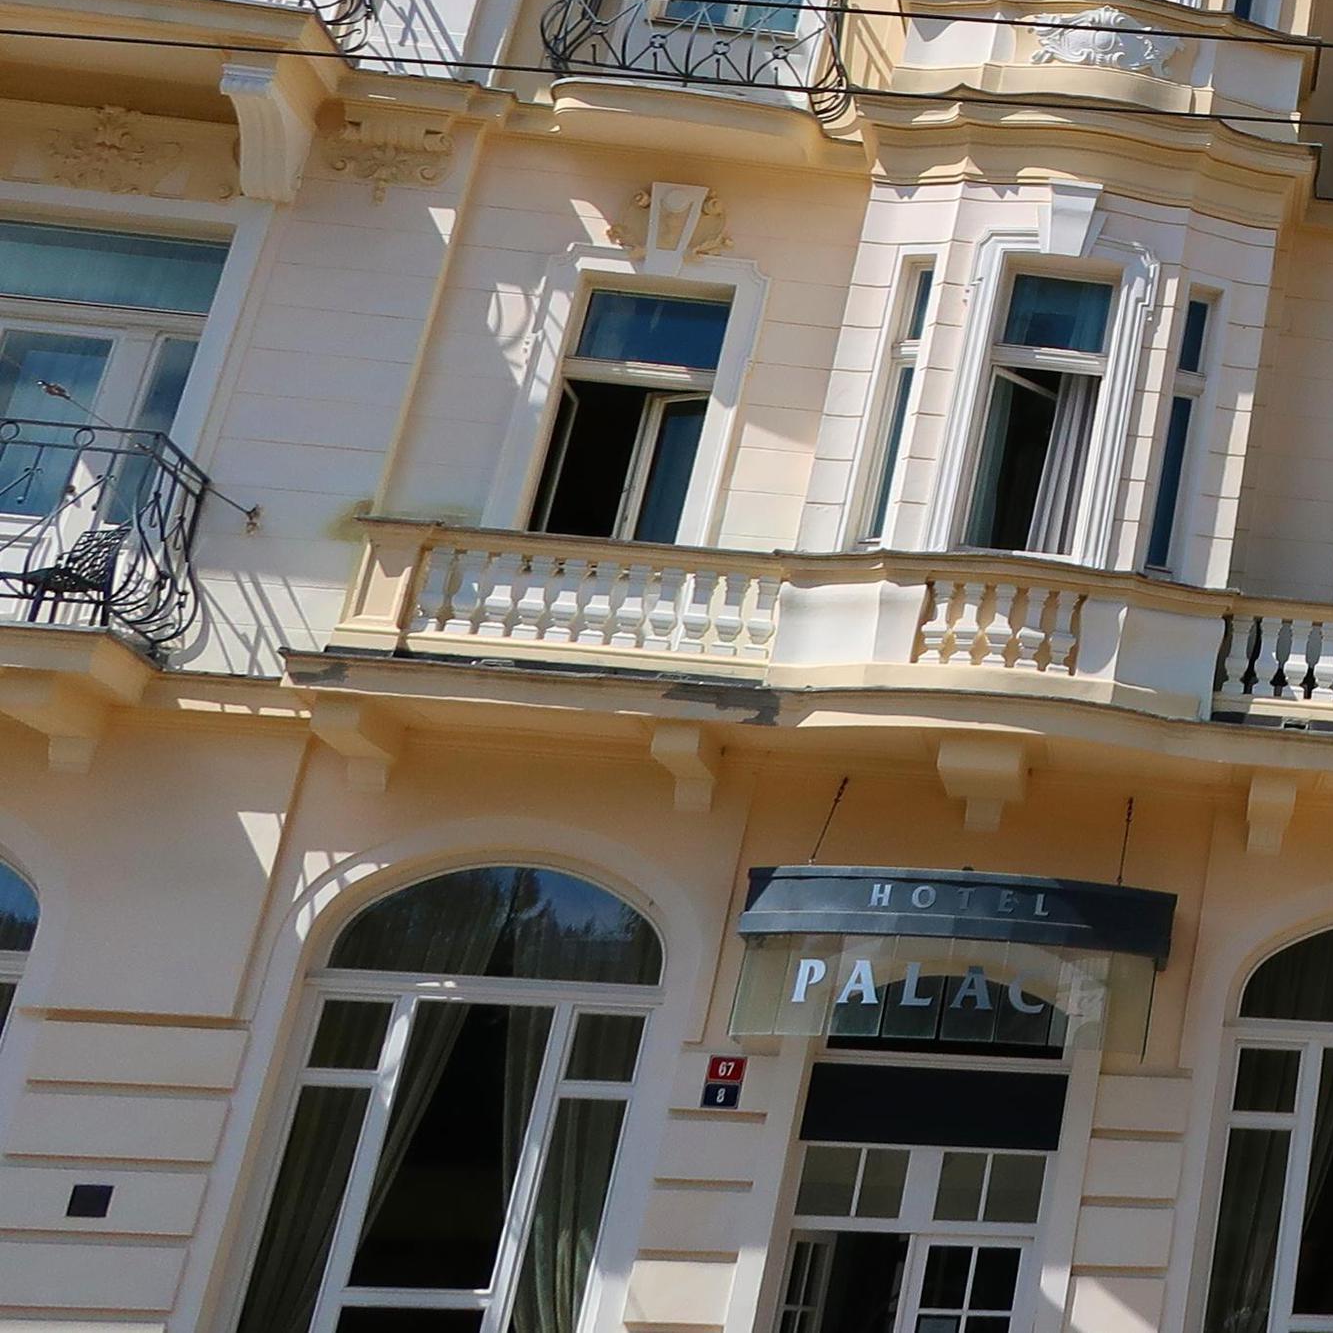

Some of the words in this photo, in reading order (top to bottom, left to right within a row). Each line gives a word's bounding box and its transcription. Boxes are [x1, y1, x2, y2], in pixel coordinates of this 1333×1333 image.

[868, 883, 1050, 916] HOTEL
[718, 1061, 736, 1077] 67
[716, 1088, 726, 1103] 8
